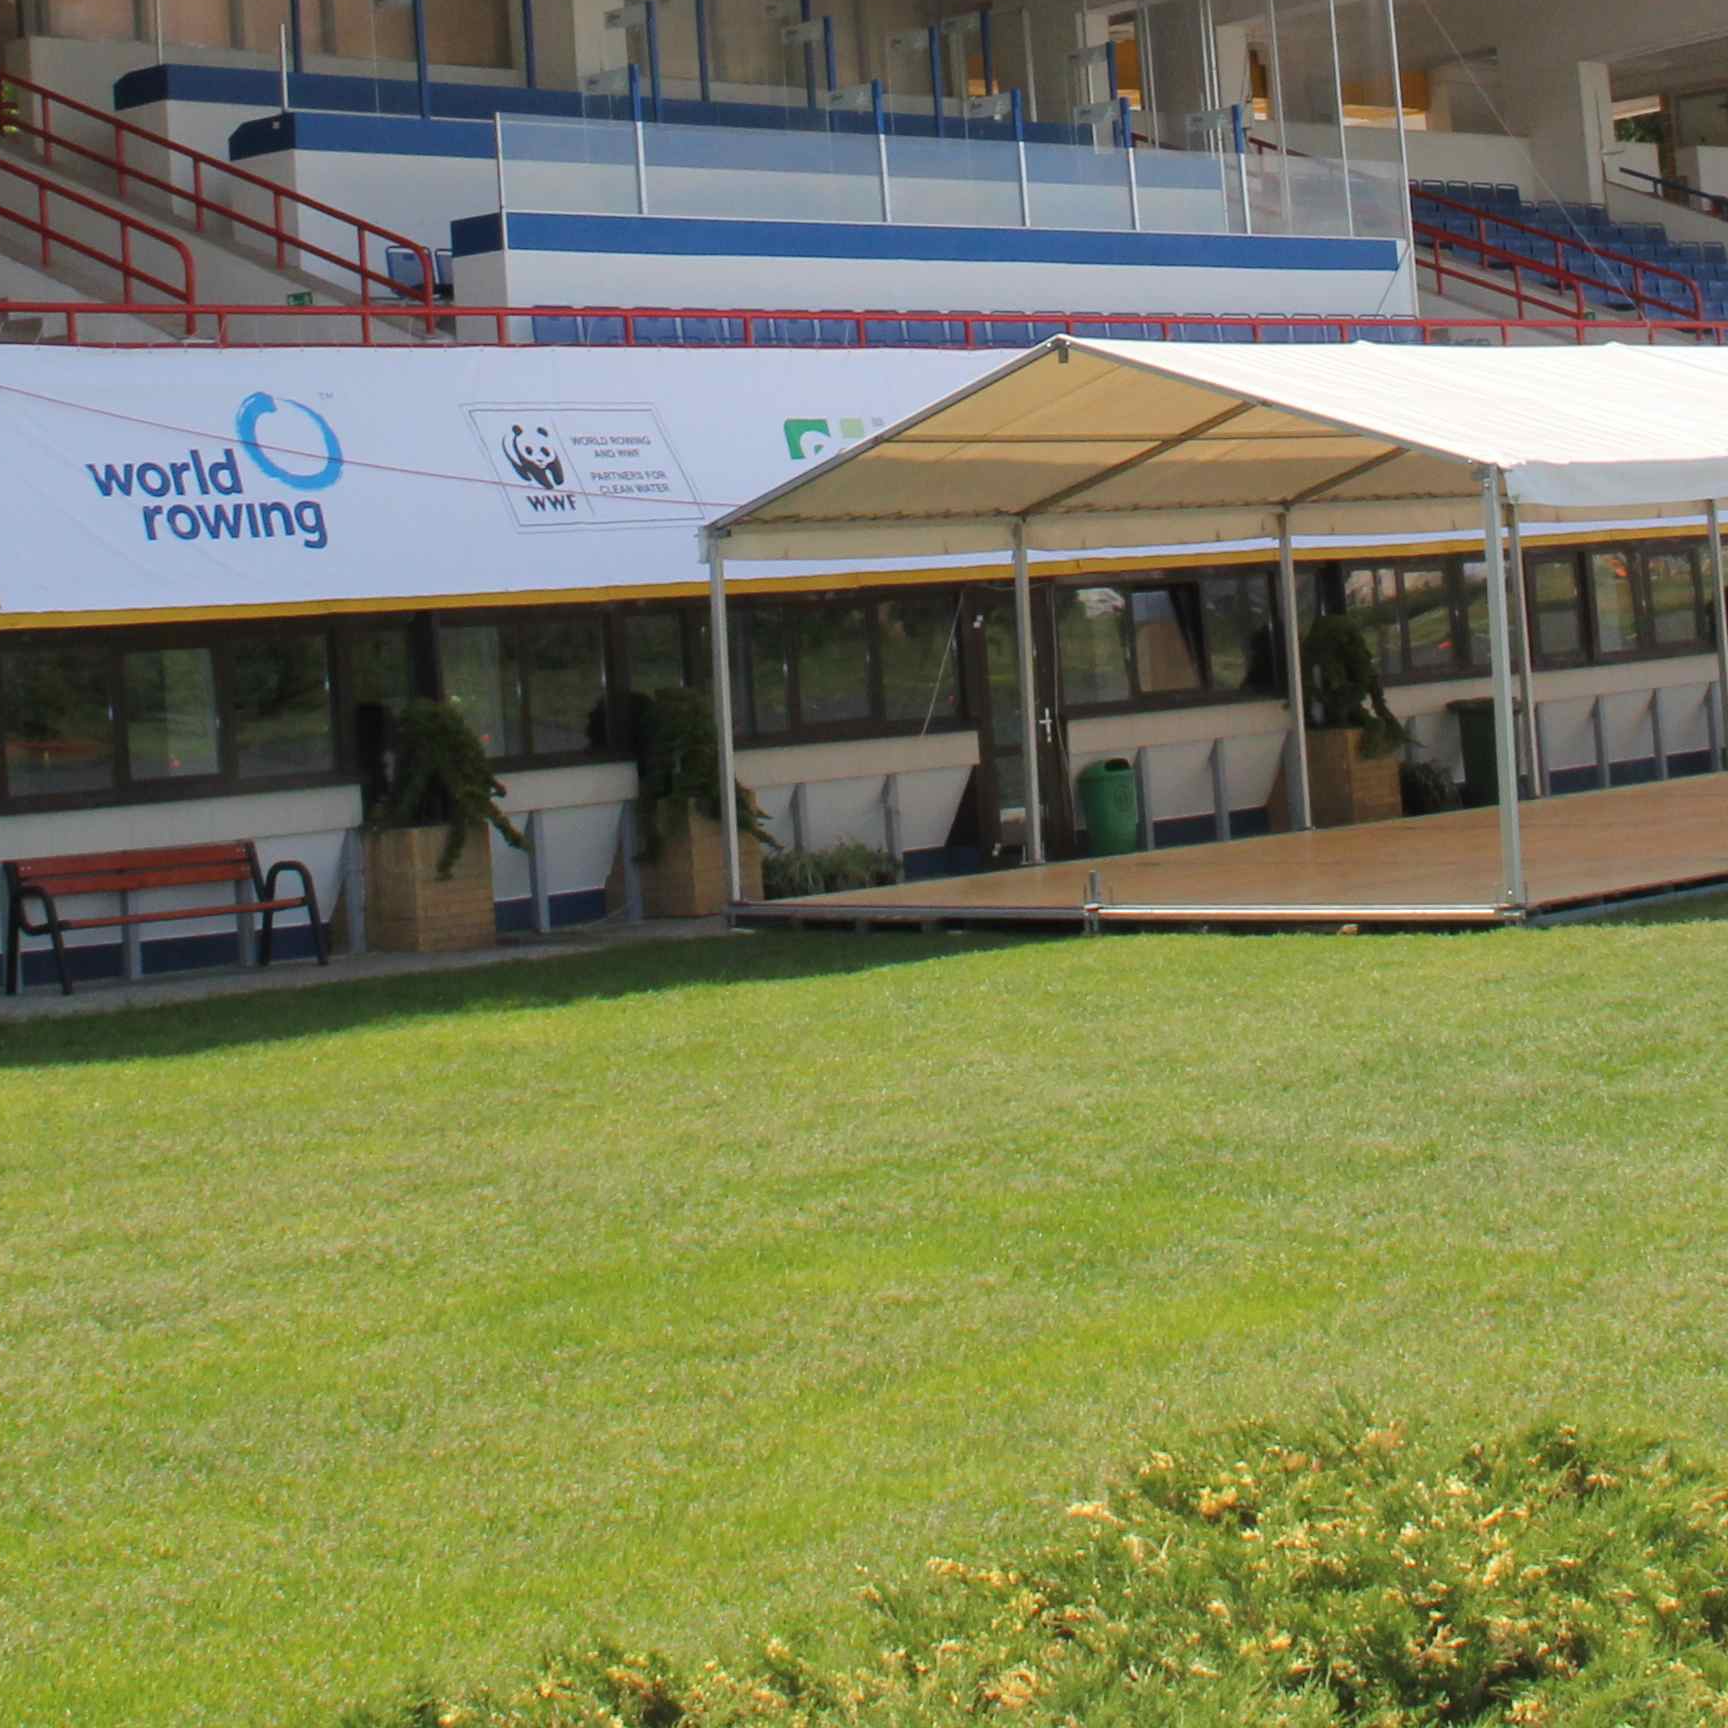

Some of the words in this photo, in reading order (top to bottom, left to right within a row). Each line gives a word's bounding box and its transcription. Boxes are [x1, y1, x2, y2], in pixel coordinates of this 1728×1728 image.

[571, 435, 608, 446] WORLD
[609, 435, 651, 446] ROWING
[594, 449, 616, 458] AND
[86, 448, 243, 497] world
[590, 471, 643, 481] PARTNERS
[644, 470, 667, 480] FOR
[600, 484, 634, 495] CLEAN
[635, 483, 671, 493] WATER
[526, 494, 577, 512] WWF
[142, 500, 328, 550] rowing
